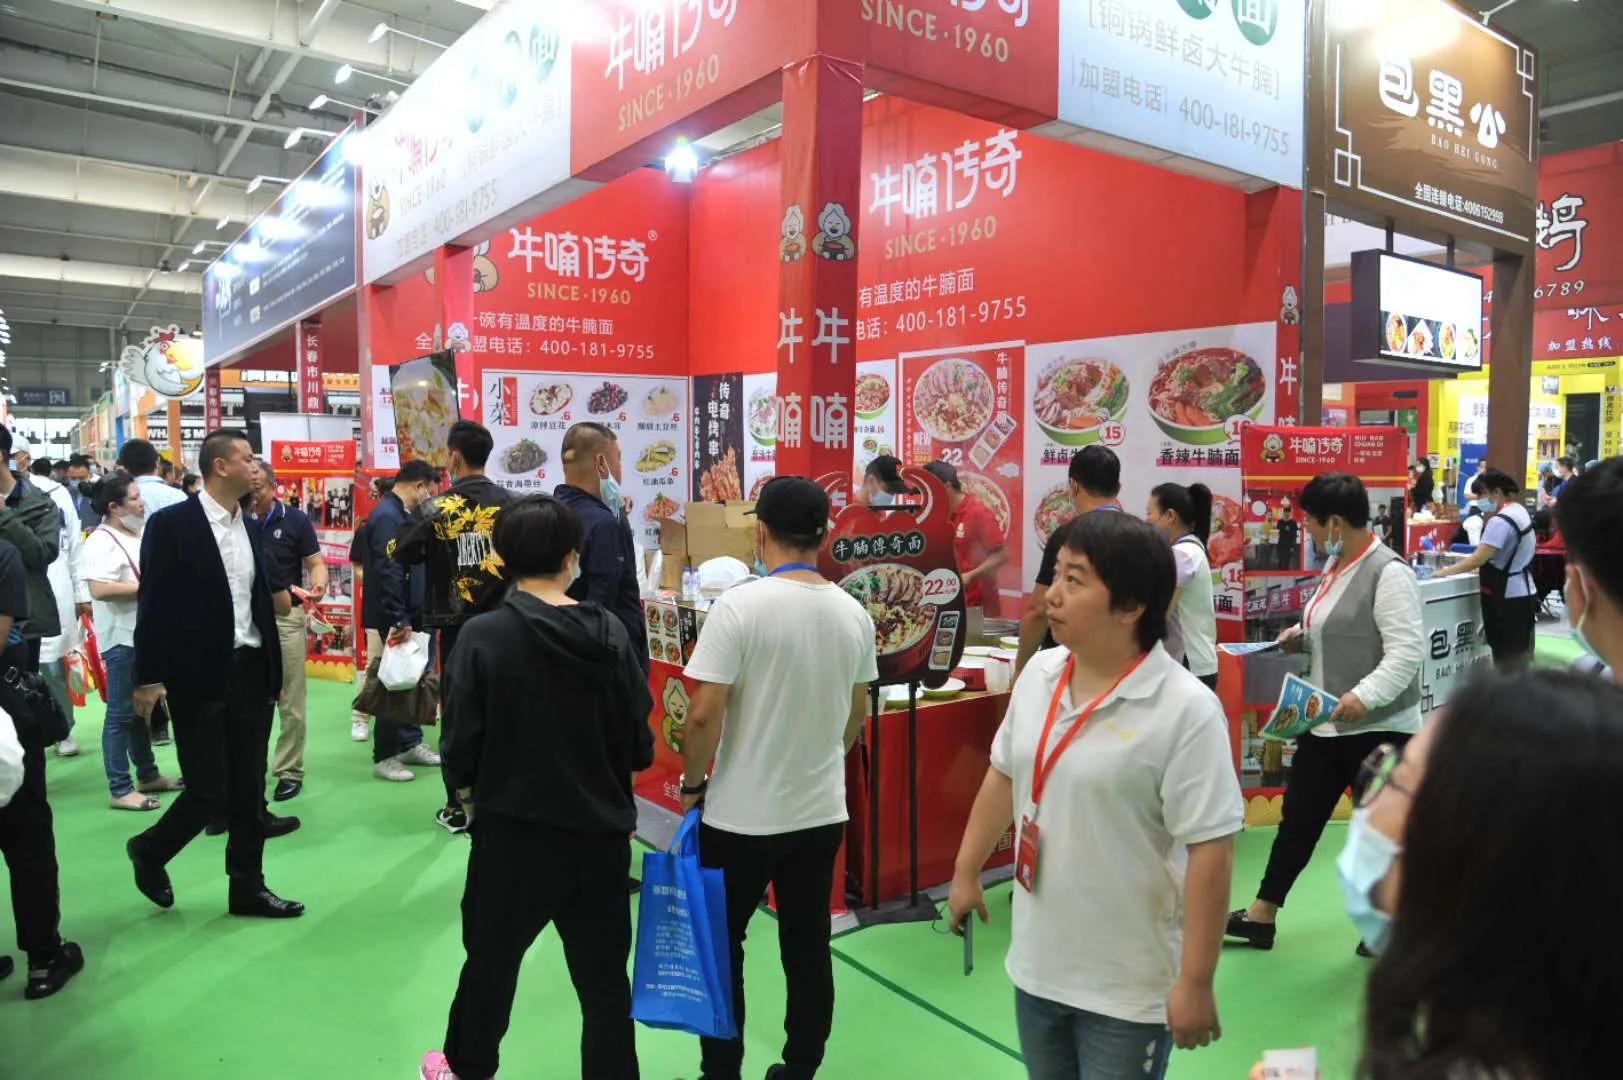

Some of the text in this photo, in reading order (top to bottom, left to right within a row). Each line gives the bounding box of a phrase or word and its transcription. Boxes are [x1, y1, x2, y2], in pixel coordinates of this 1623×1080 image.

[1178, 95, 1290, 156] 400-181-9755
[473, 310, 614, 336] 碗有温度的牛腩面
[895, 295, 1027, 333] 400-181-9755
[540, 339, 655, 360] 400-181-9755
[1104, 426, 1121, 440] 15
[1160, 448, 1240, 467] 香辣牛腩面
